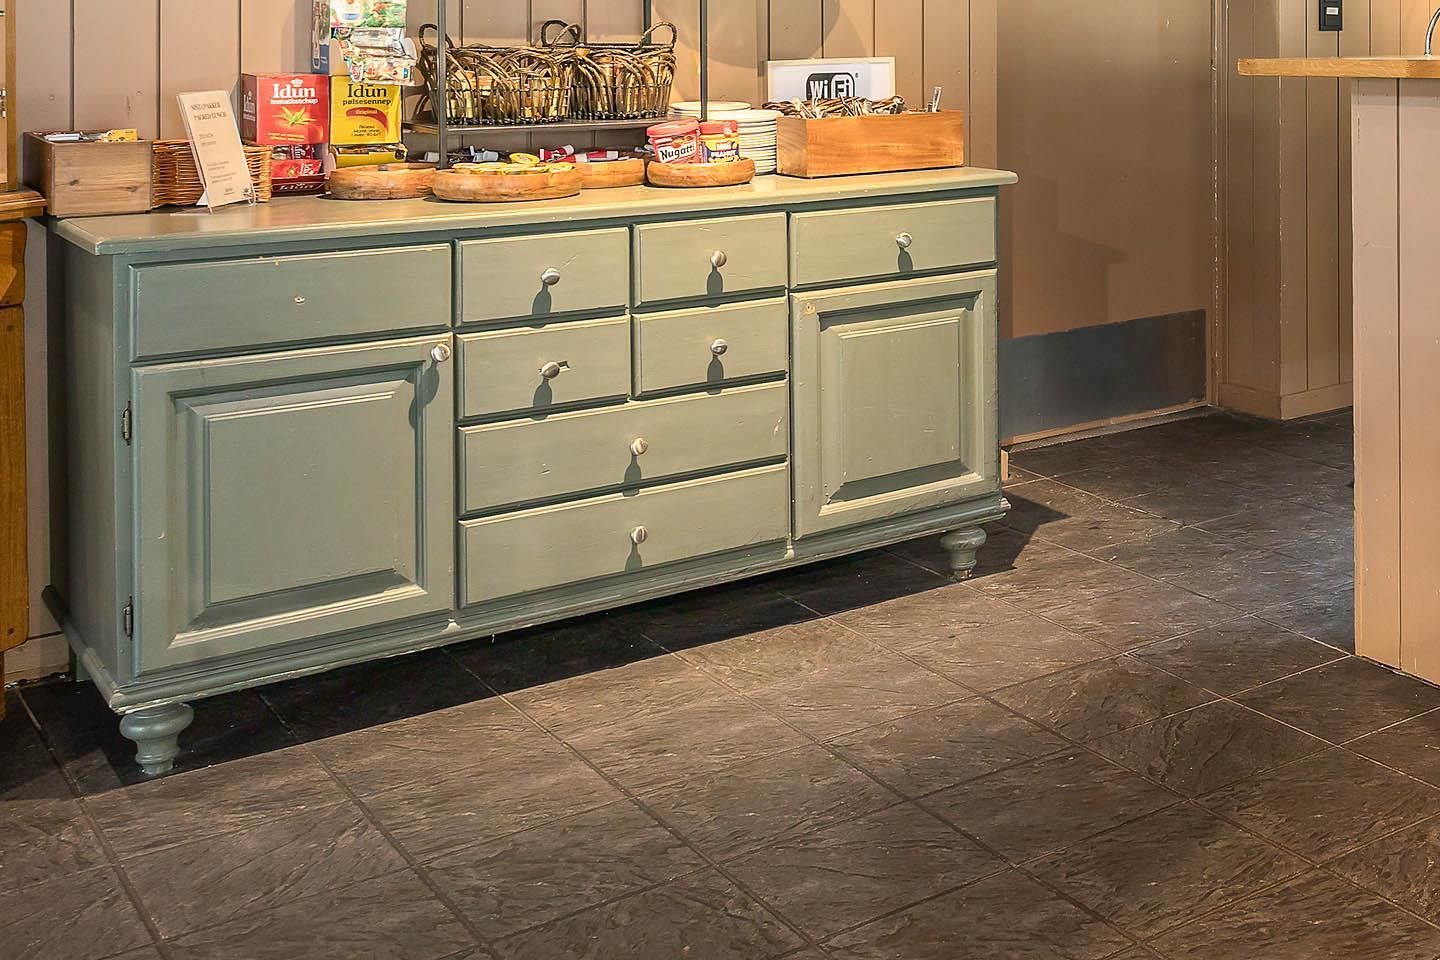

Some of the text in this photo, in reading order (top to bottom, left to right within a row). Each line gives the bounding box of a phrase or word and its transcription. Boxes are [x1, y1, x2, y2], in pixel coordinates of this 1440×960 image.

[272, 82, 316, 99] Idun
[347, 83, 387, 98] Idun
[342, 98, 391, 106] pølsesennep
[659, 143, 696, 161] Nugatti
